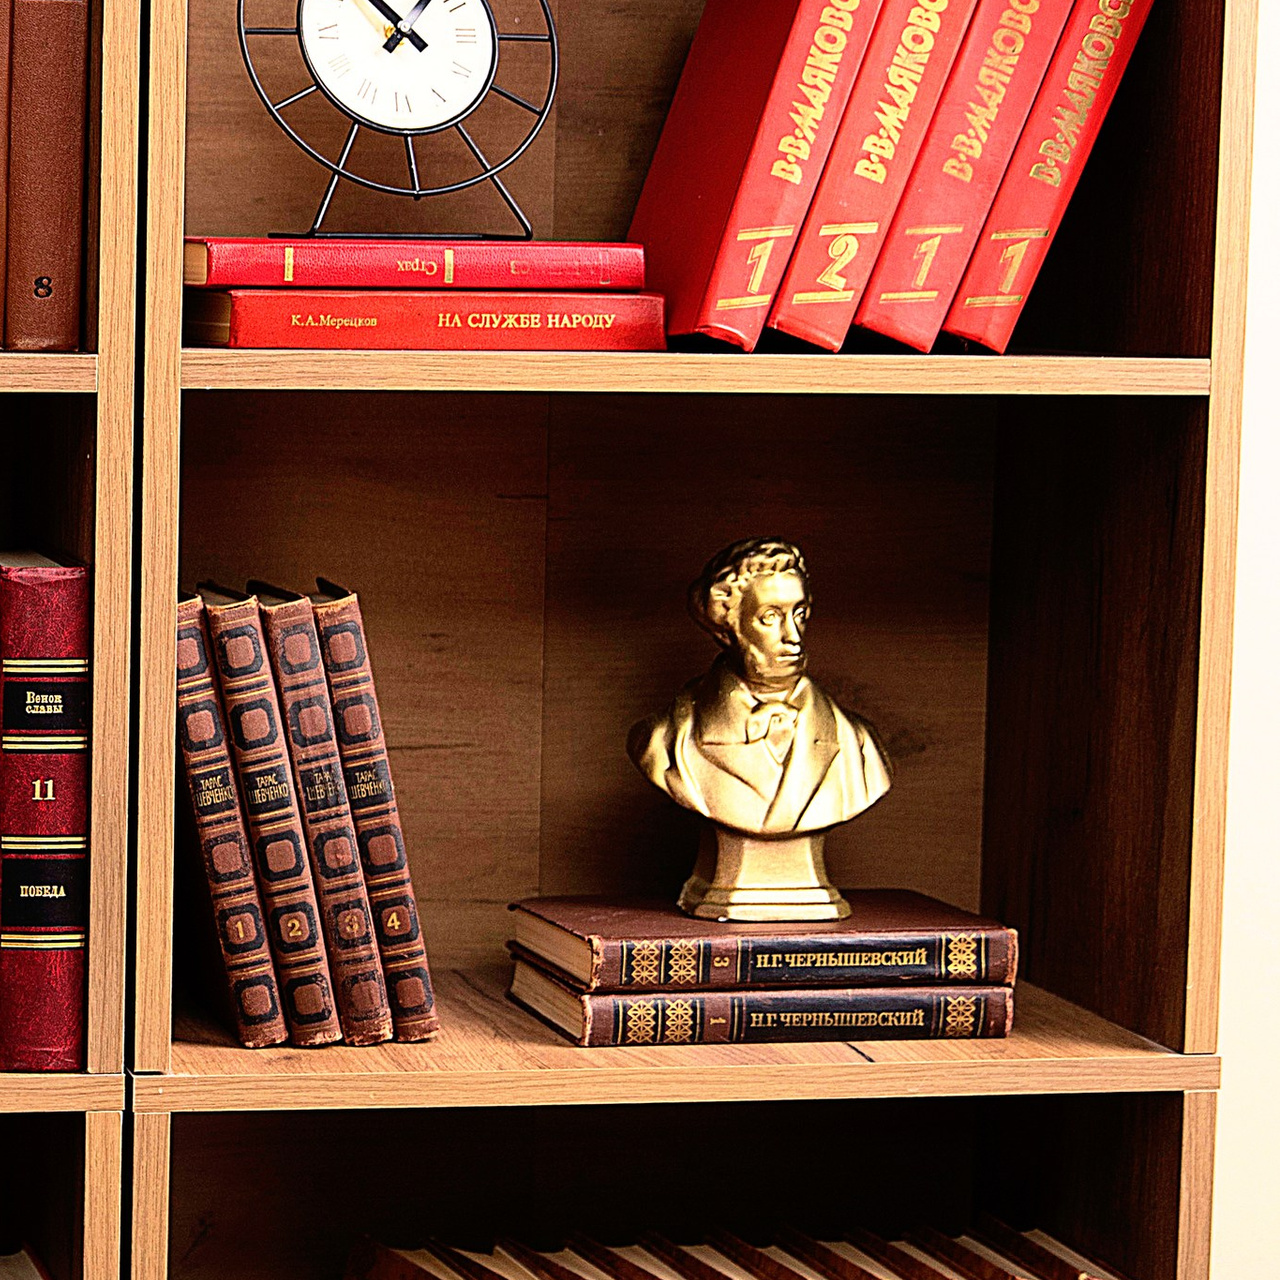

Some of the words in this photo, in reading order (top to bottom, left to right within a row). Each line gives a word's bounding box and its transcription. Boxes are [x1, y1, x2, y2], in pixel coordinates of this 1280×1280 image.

[397, 259, 438, 275] Страх
[747, 238, 775, 294] 1
[817, 233, 859, 291] 2
[913, 235, 942, 289] 1
[33, 276, 53, 299] 8
[438, 313, 462, 328] НА
[467, 313, 541, 328] СЛУЖБЕ
[546, 313, 616, 329] НАРОДУ
[200, 776, 223, 791] ТАРАС
[255, 773, 278, 787] ТАРАС
[355, 769, 377, 784] ТАРАС
[32, 779, 56, 801] 11
[248, 783, 289, 804] ШЕВЧЕНКО
[20, 885, 66, 898] ПОБЕДА
[387, 911, 401, 929] 4
[756, 954, 782, 968] Н.Г.
[785, 948, 927, 967] ЧЕРНЫШЕВСКИЙ
[750, 1013, 777, 1027] Н.Г.
[780, 1009, 925, 1027] ЧЕРНЫШЕВСКИЙ
